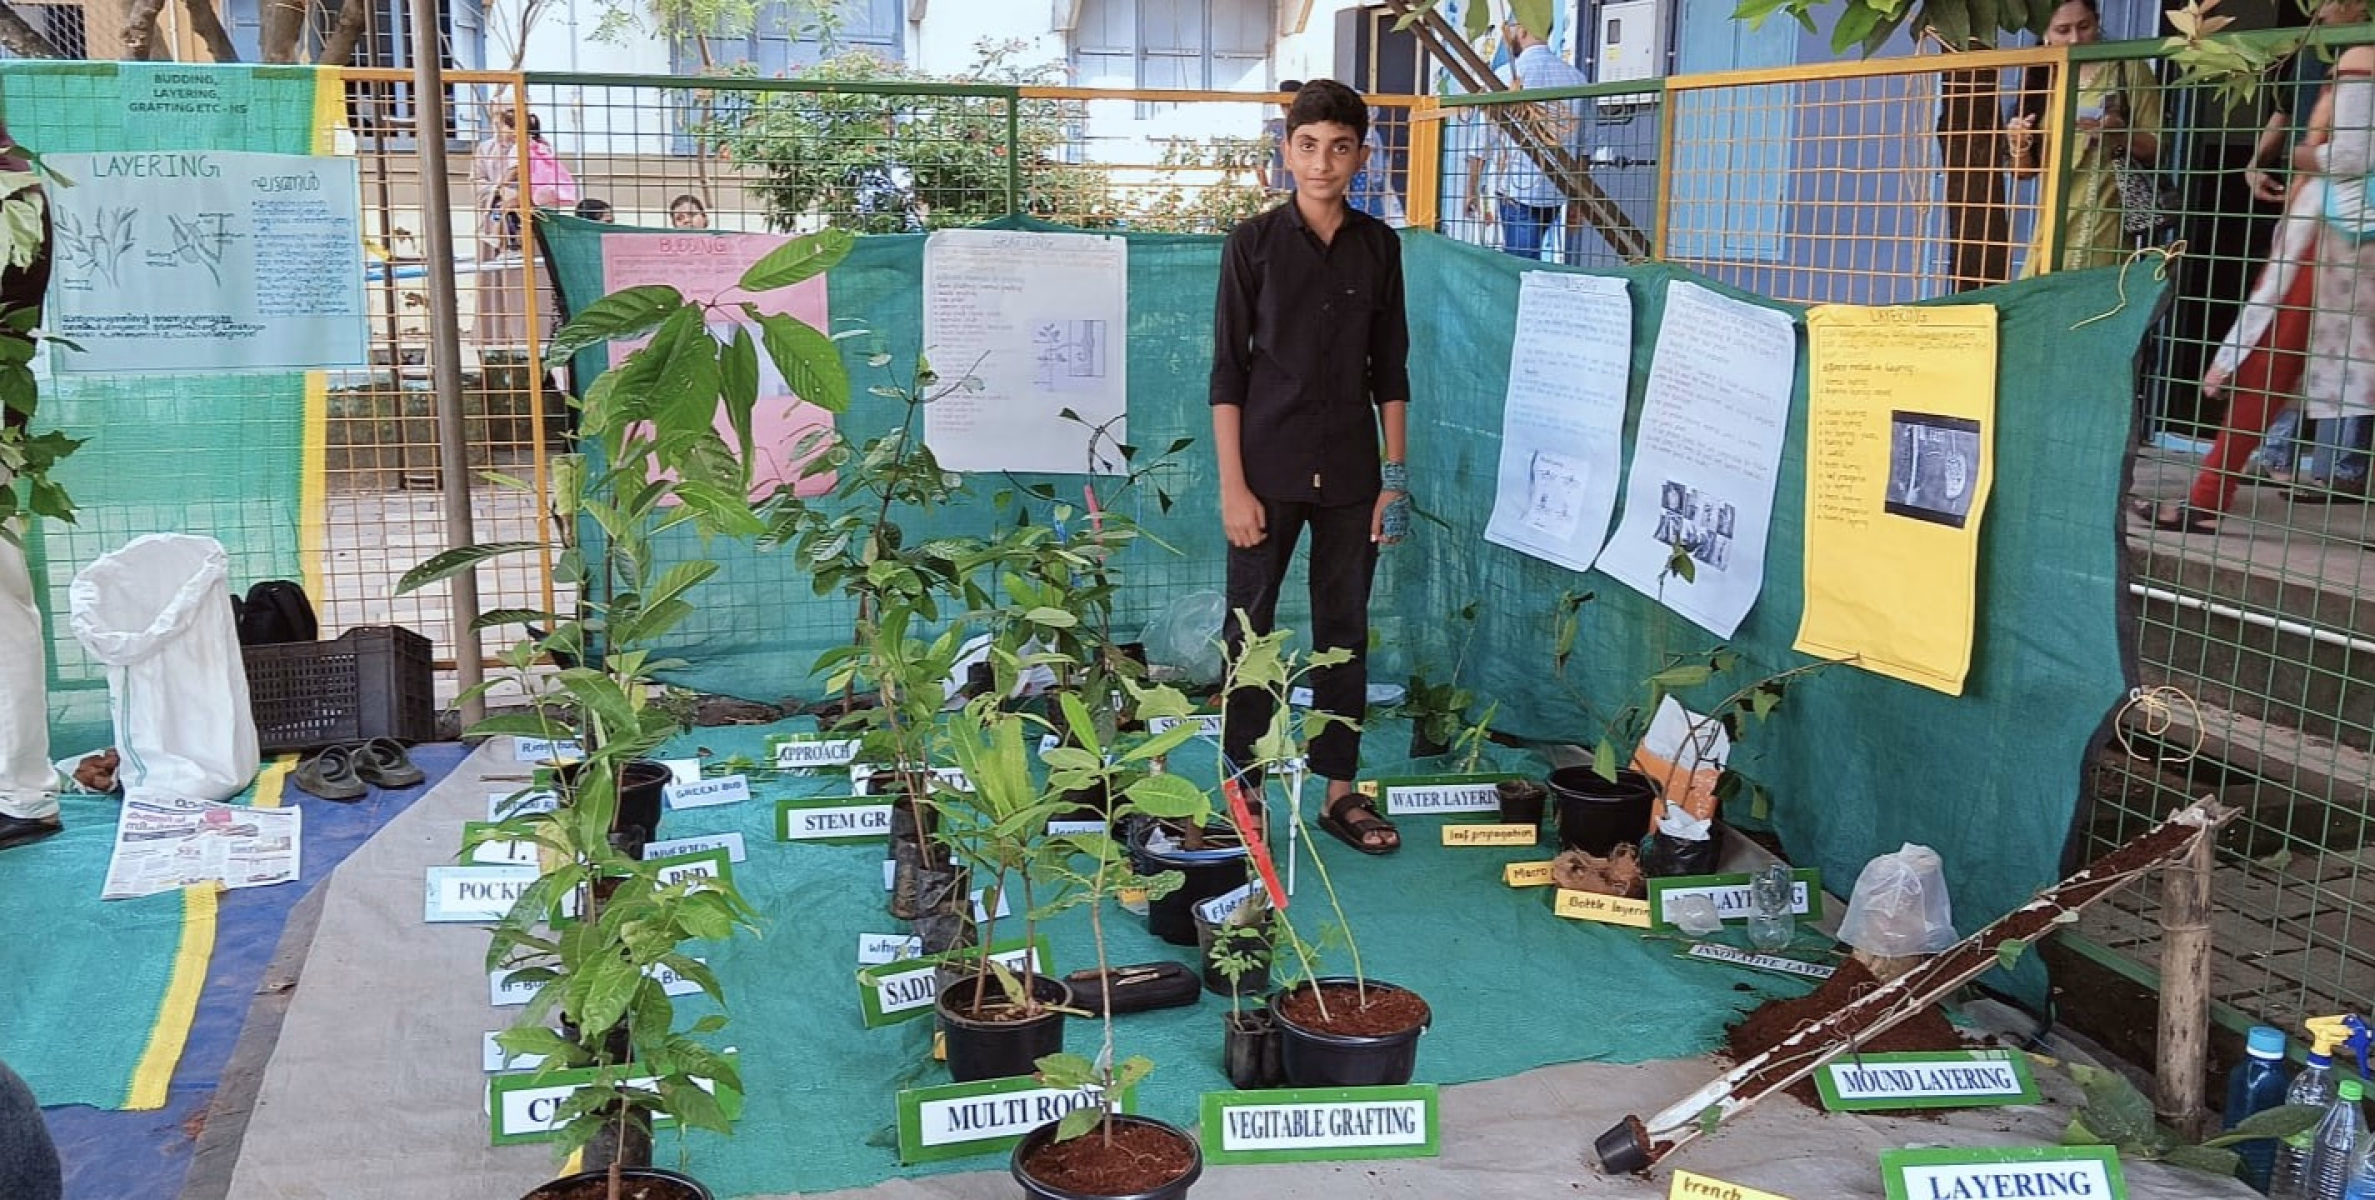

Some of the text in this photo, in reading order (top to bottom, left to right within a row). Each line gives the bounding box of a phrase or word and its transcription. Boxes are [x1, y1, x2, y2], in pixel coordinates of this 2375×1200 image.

[154, 74, 218, 86] BUDDING,
[153, 89, 220, 101] LAYERING,
[129, 102, 195, 113] GRAFTING
[196, 104, 220, 113] ETC
[93, 154, 221, 178] LAYERING
[780, 744, 850, 761] APPROACH
[675, 784, 718, 799] GREEN
[1392, 788, 1501, 808] WATER LAYERIN
[804, 810, 891, 831] STEM GR
[458, 880, 531, 901] POCKE
[1568, 896, 1605, 911] Bottle
[1842, 1067, 2012, 1093] MOUND LAYERING
[947, 1099, 1028, 1132] MULTI
[1228, 1105, 1416, 1141] VEGITABLE GRAFTING
[1929, 1171, 2091, 1200] LAYERING
